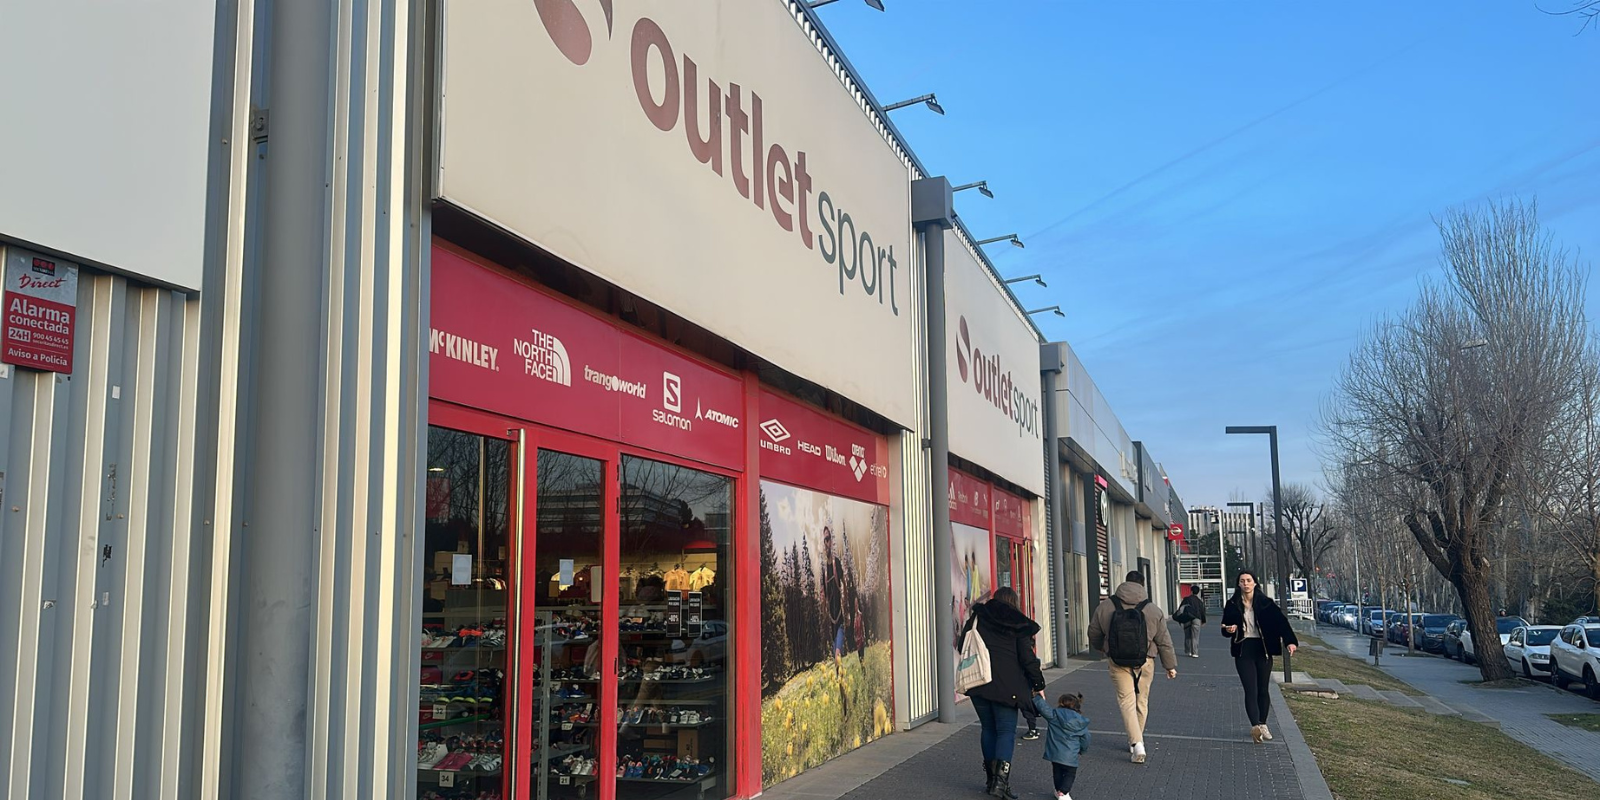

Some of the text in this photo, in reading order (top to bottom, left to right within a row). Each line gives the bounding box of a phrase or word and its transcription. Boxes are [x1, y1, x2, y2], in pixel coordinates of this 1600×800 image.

[19, 273, 67, 288] Direct
[10, 298, 70, 325] Alarma
[9, 314, 69, 335] conectada
[9, 328, 30, 341] 24H
[33, 332, 45, 340] 900
[531, 328, 553, 349] THE
[8, 348, 31, 359] Aviso
[40, 353, 68, 366] Policía
[513, 338, 553, 367] NORTH
[525, 359, 553, 383] FACE
[704, 408, 739, 429] ATOMIC
[797, 440, 821, 456] HEAD
[825, 444, 846, 466] Wilson
[1293, 580, 1304, 591] P
